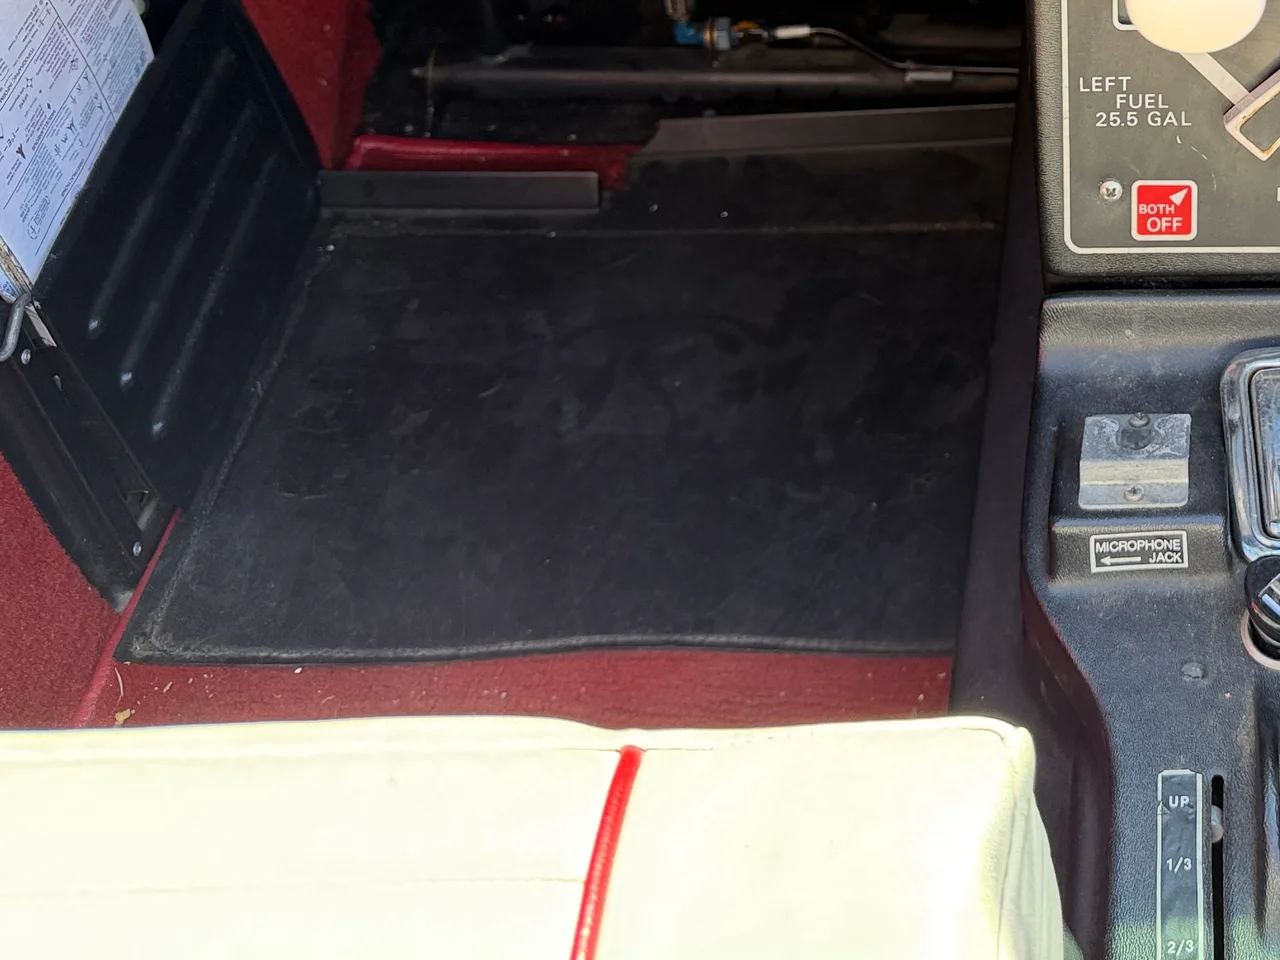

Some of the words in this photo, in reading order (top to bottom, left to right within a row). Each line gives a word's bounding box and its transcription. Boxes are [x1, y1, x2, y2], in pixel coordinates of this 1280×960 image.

[1079, 76, 1132, 92] LEFT
[1115, 93, 1169, 110] FUEL
[1095, 111, 1138, 127] 25.5
[1146, 111, 1192, 127] GAL
[1138, 202, 1176, 216] BOTH
[1146, 217, 1183, 233] OFF
[1095, 538, 1181, 554] MICROPHONE
[1148, 551, 1182, 564] JACK
[1168, 795, 1189, 808] UP
[1166, 857, 1192, 872] 1/3
[1167, 939, 1194, 955] 2/3
